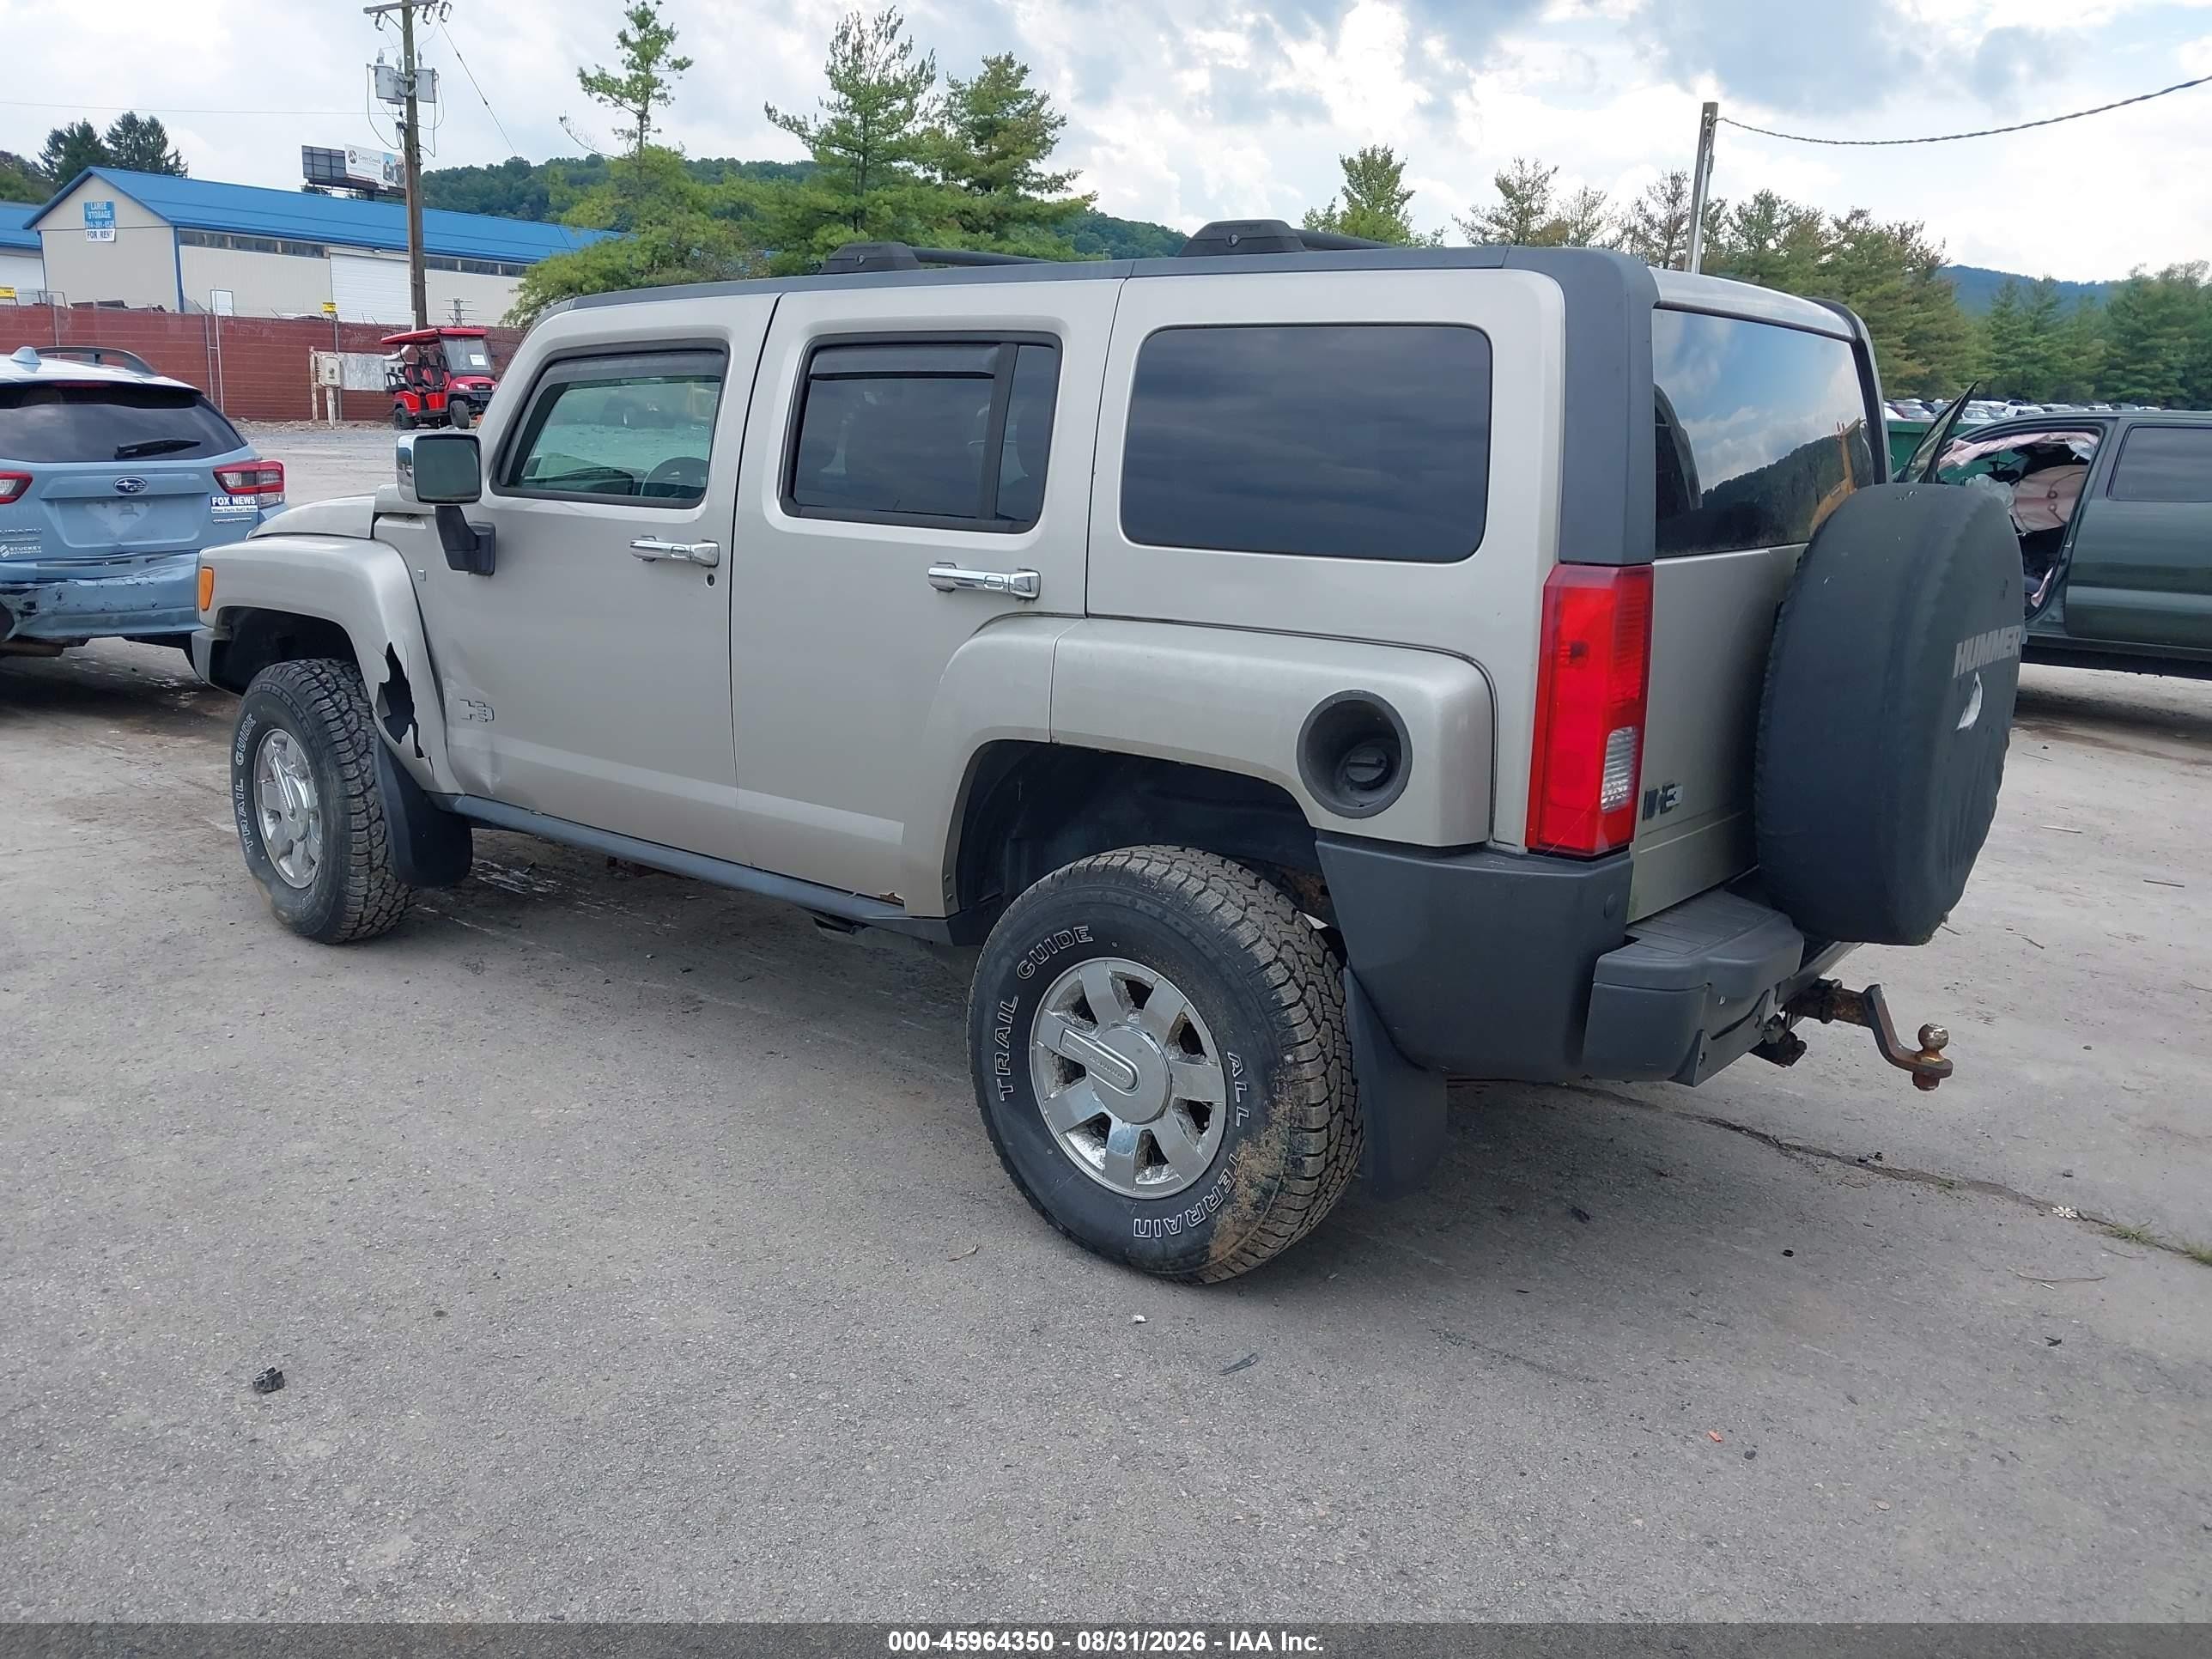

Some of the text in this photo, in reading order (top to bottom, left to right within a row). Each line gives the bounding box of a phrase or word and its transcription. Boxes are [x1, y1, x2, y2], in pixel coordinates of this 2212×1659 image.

[88, 210, 111, 219] STORAGE
[91, 202, 107, 210] LARGE
[212, 495, 256, 506] FOX NEWS
[1953, 625, 2022, 678] HUMMER
[234, 714, 257, 854] TRAIL GUIDE
[992, 926, 1094, 1102] TRAIL GUIDE
[1133, 1051, 1250, 1238] ALL TERRAIN
